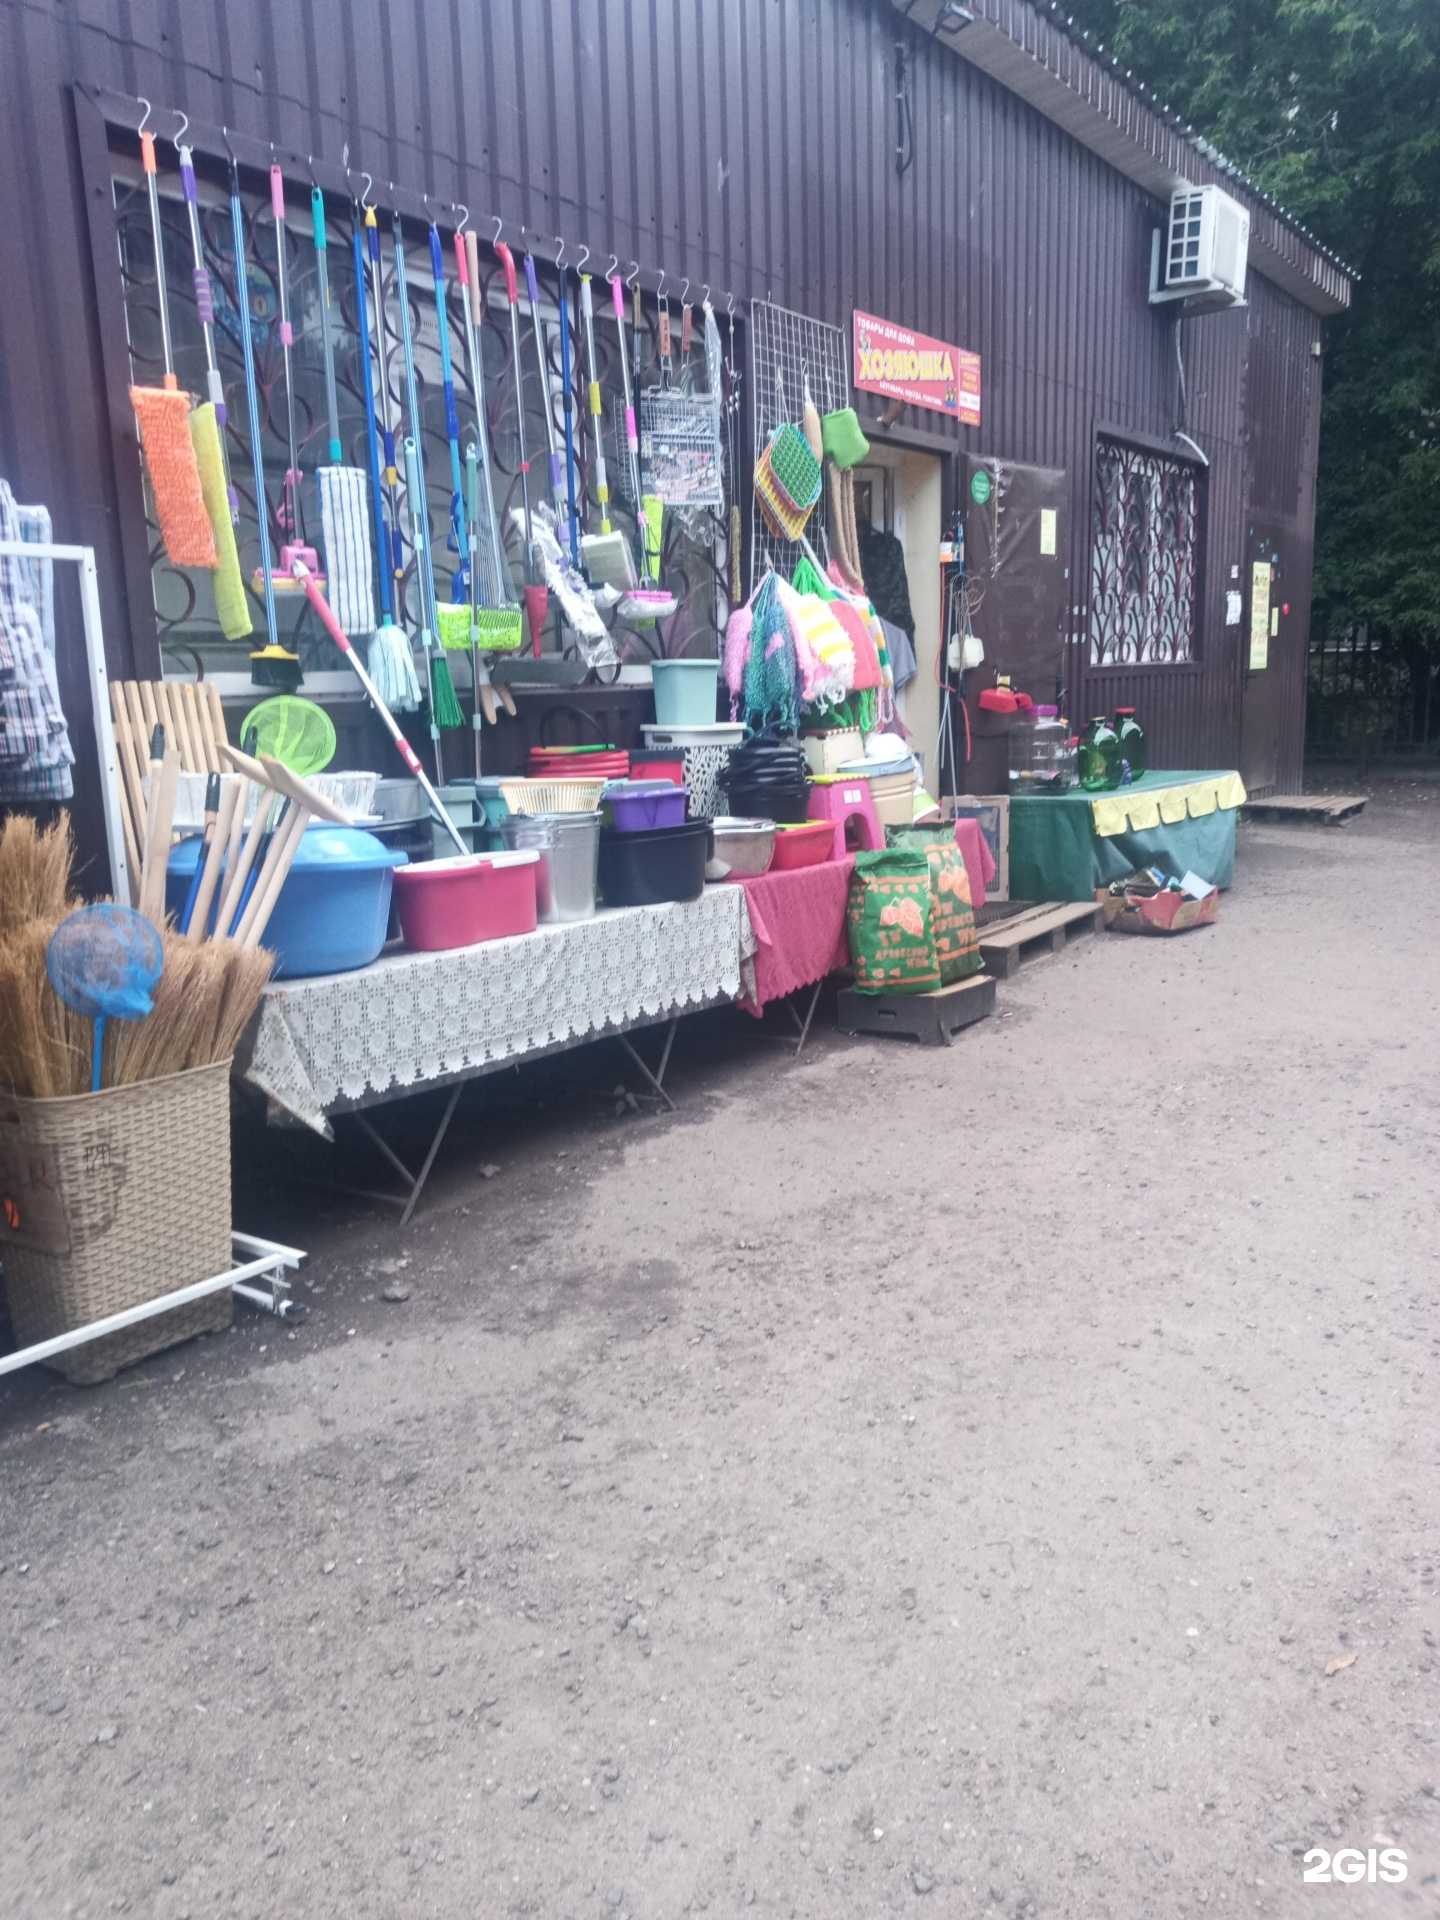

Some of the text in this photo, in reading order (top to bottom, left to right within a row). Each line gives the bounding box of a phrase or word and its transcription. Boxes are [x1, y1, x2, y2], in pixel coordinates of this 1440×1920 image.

[857, 317, 915, 347] ТОВАРЫ ДЛЯ ДОМА
[857, 348, 954, 381] ХОЗЯЮШКА
